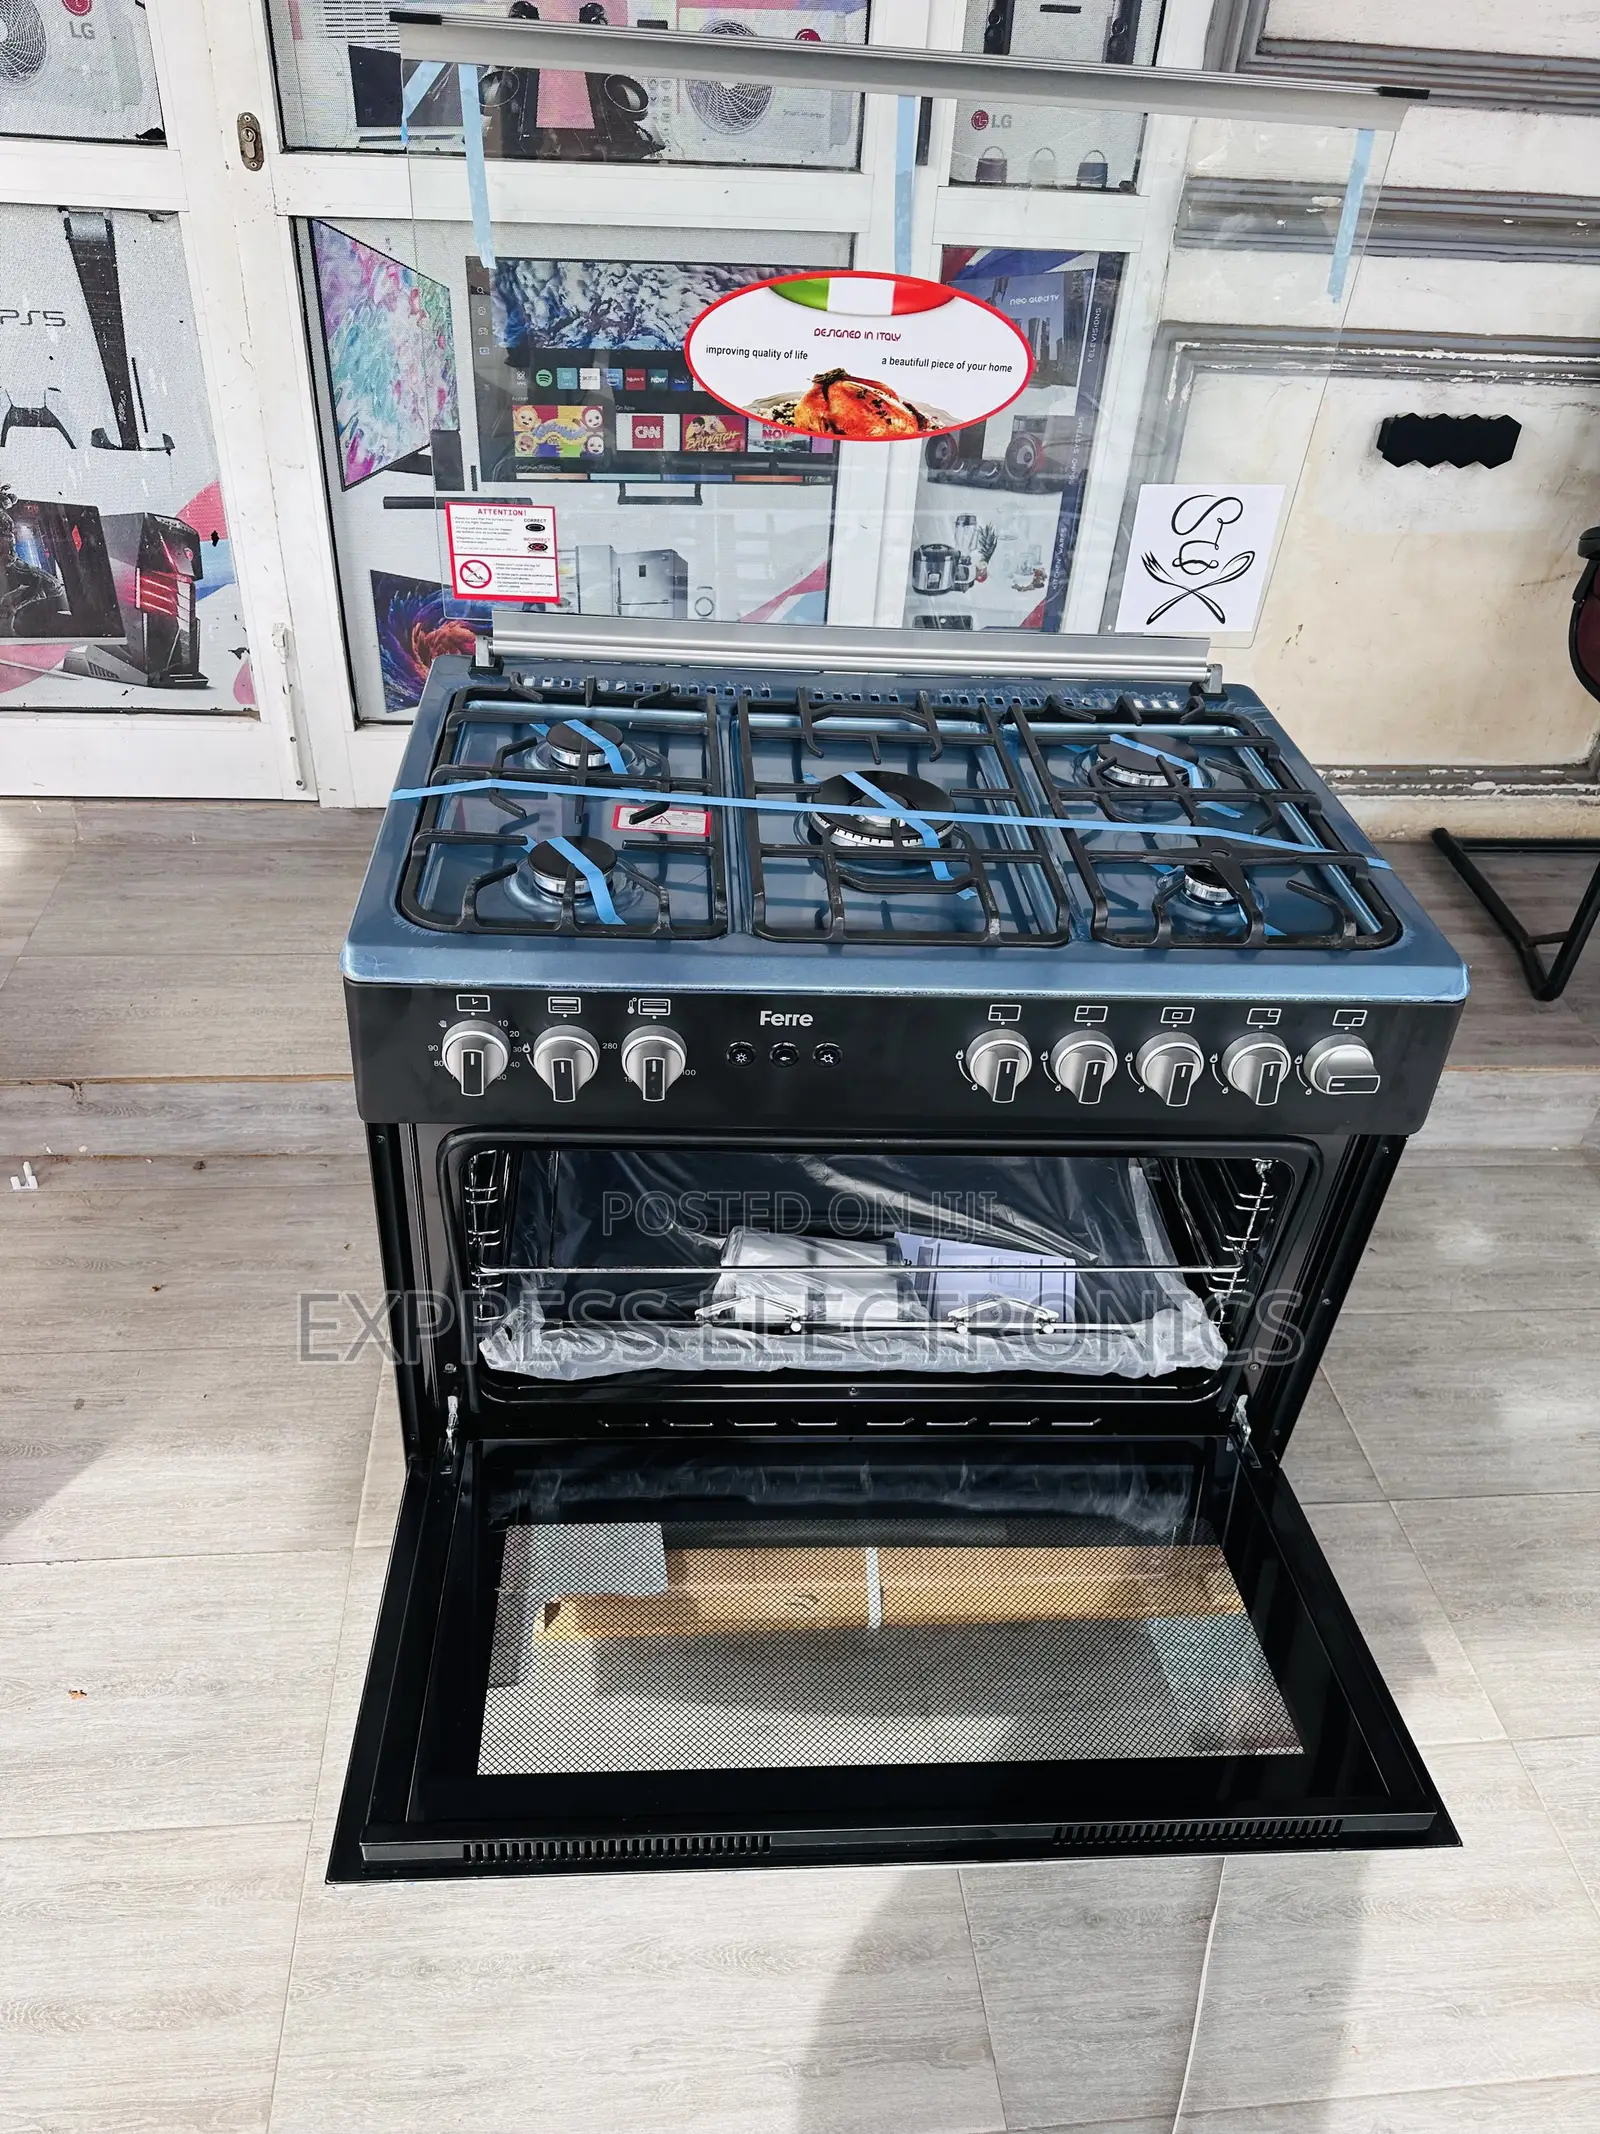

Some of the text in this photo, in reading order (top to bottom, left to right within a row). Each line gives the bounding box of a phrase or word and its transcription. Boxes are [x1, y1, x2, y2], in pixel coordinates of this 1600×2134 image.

[69, 21, 95, 40] LG
[991, 114, 1012, 128] LG
[0, 309, 66, 326] PS5
[814, 328, 901, 341] DESIGNED IN ITALY
[1087, 307, 1102, 363] TELEVISIONS
[706, 345, 808, 360] improving quality of life
[889, 357, 929, 367] beautifull
[931, 360, 954, 370] piece
[956, 361, 966, 369] of
[967, 363, 986, 372] your
[989, 363, 1012, 372] home
[634, 426, 660, 439] CNN
[478, 508, 527, 516] ATTENTION!
[760, 1010, 814, 1027] Ferre
[509, 1030, 520, 1038] 20
[602, 1042, 618, 1050] 280
